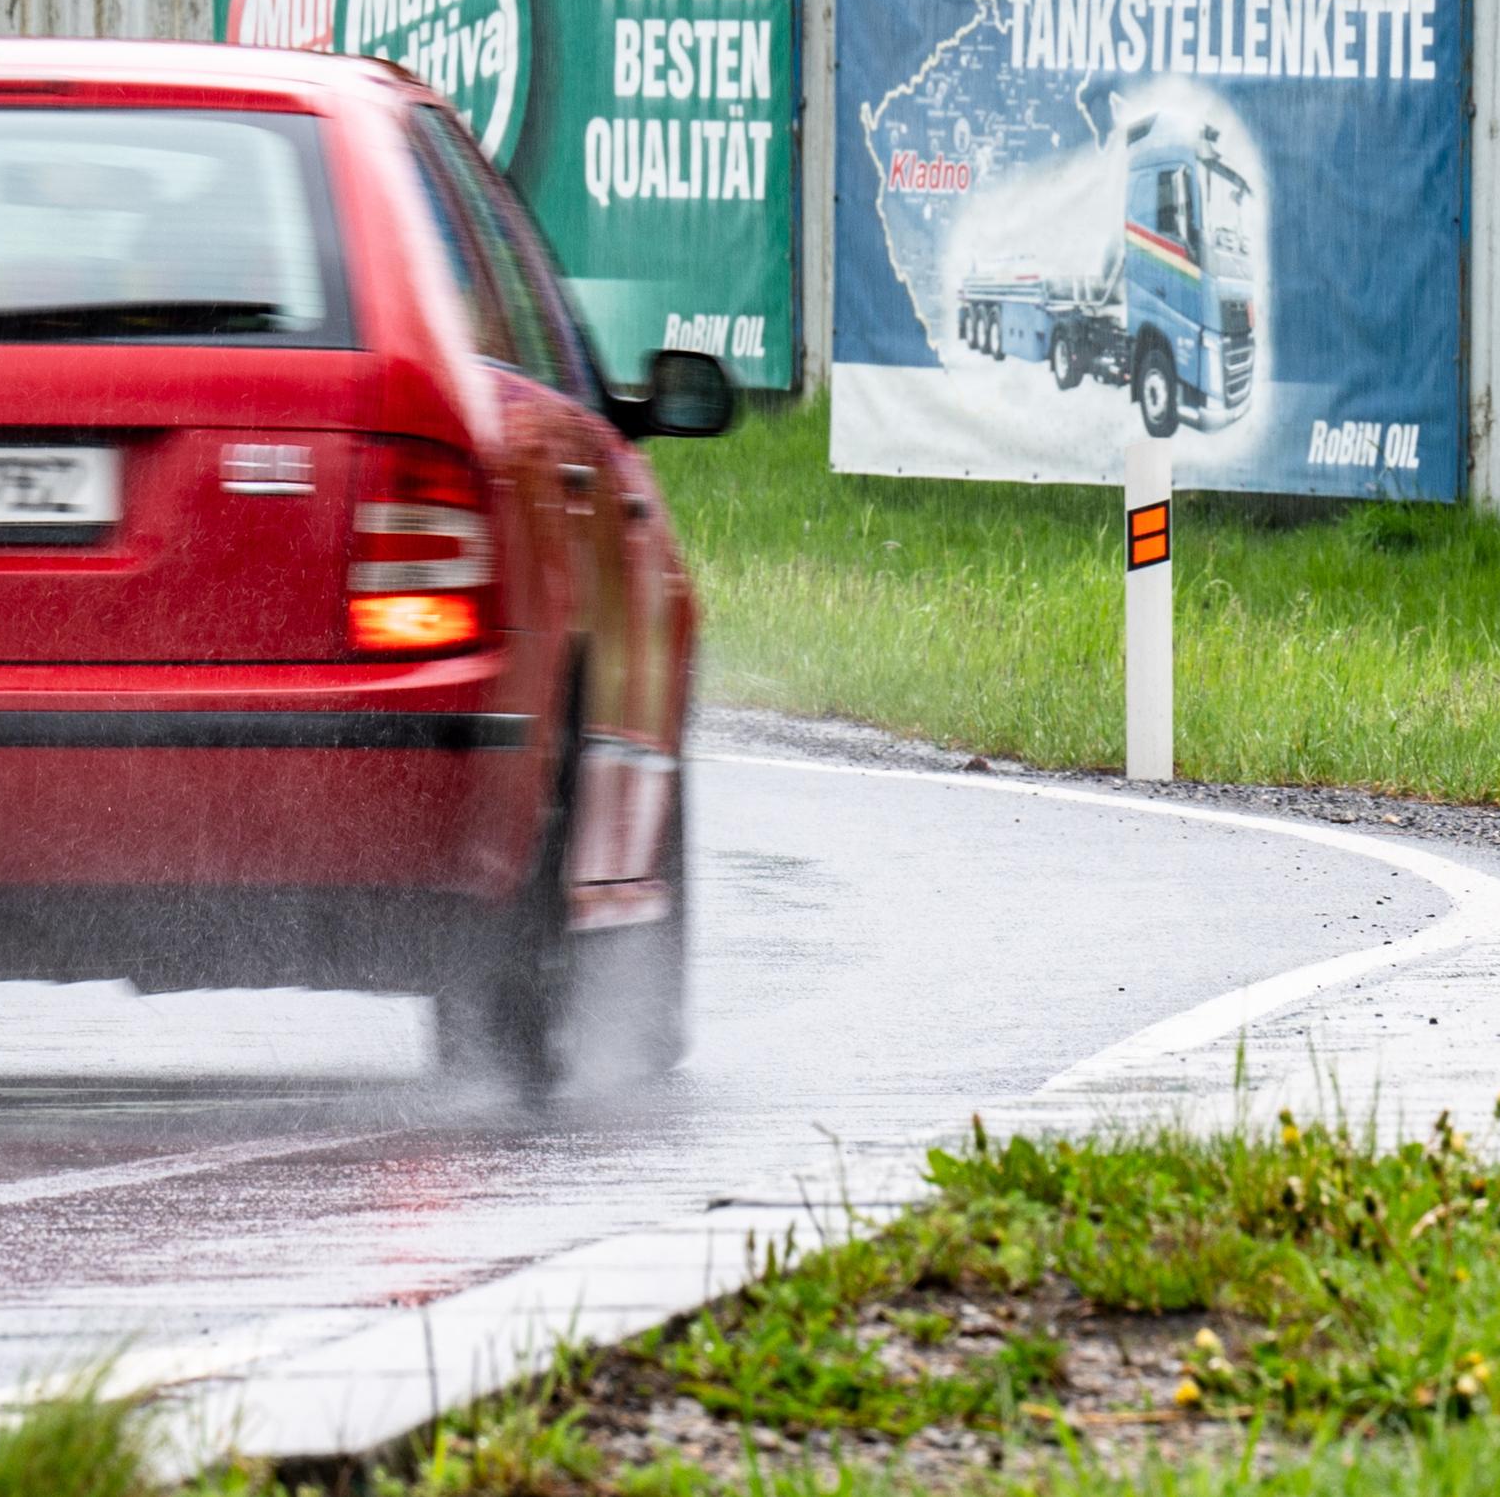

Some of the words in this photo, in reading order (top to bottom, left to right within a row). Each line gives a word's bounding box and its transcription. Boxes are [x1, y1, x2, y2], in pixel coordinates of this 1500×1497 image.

[613, 17, 772, 100] BESTEN
[585, 105, 773, 207] QUALITÄT
[889, 150, 971, 194] Kladno
[731, 316, 766, 358] OIL
[1383, 423, 1420, 470] OIL
